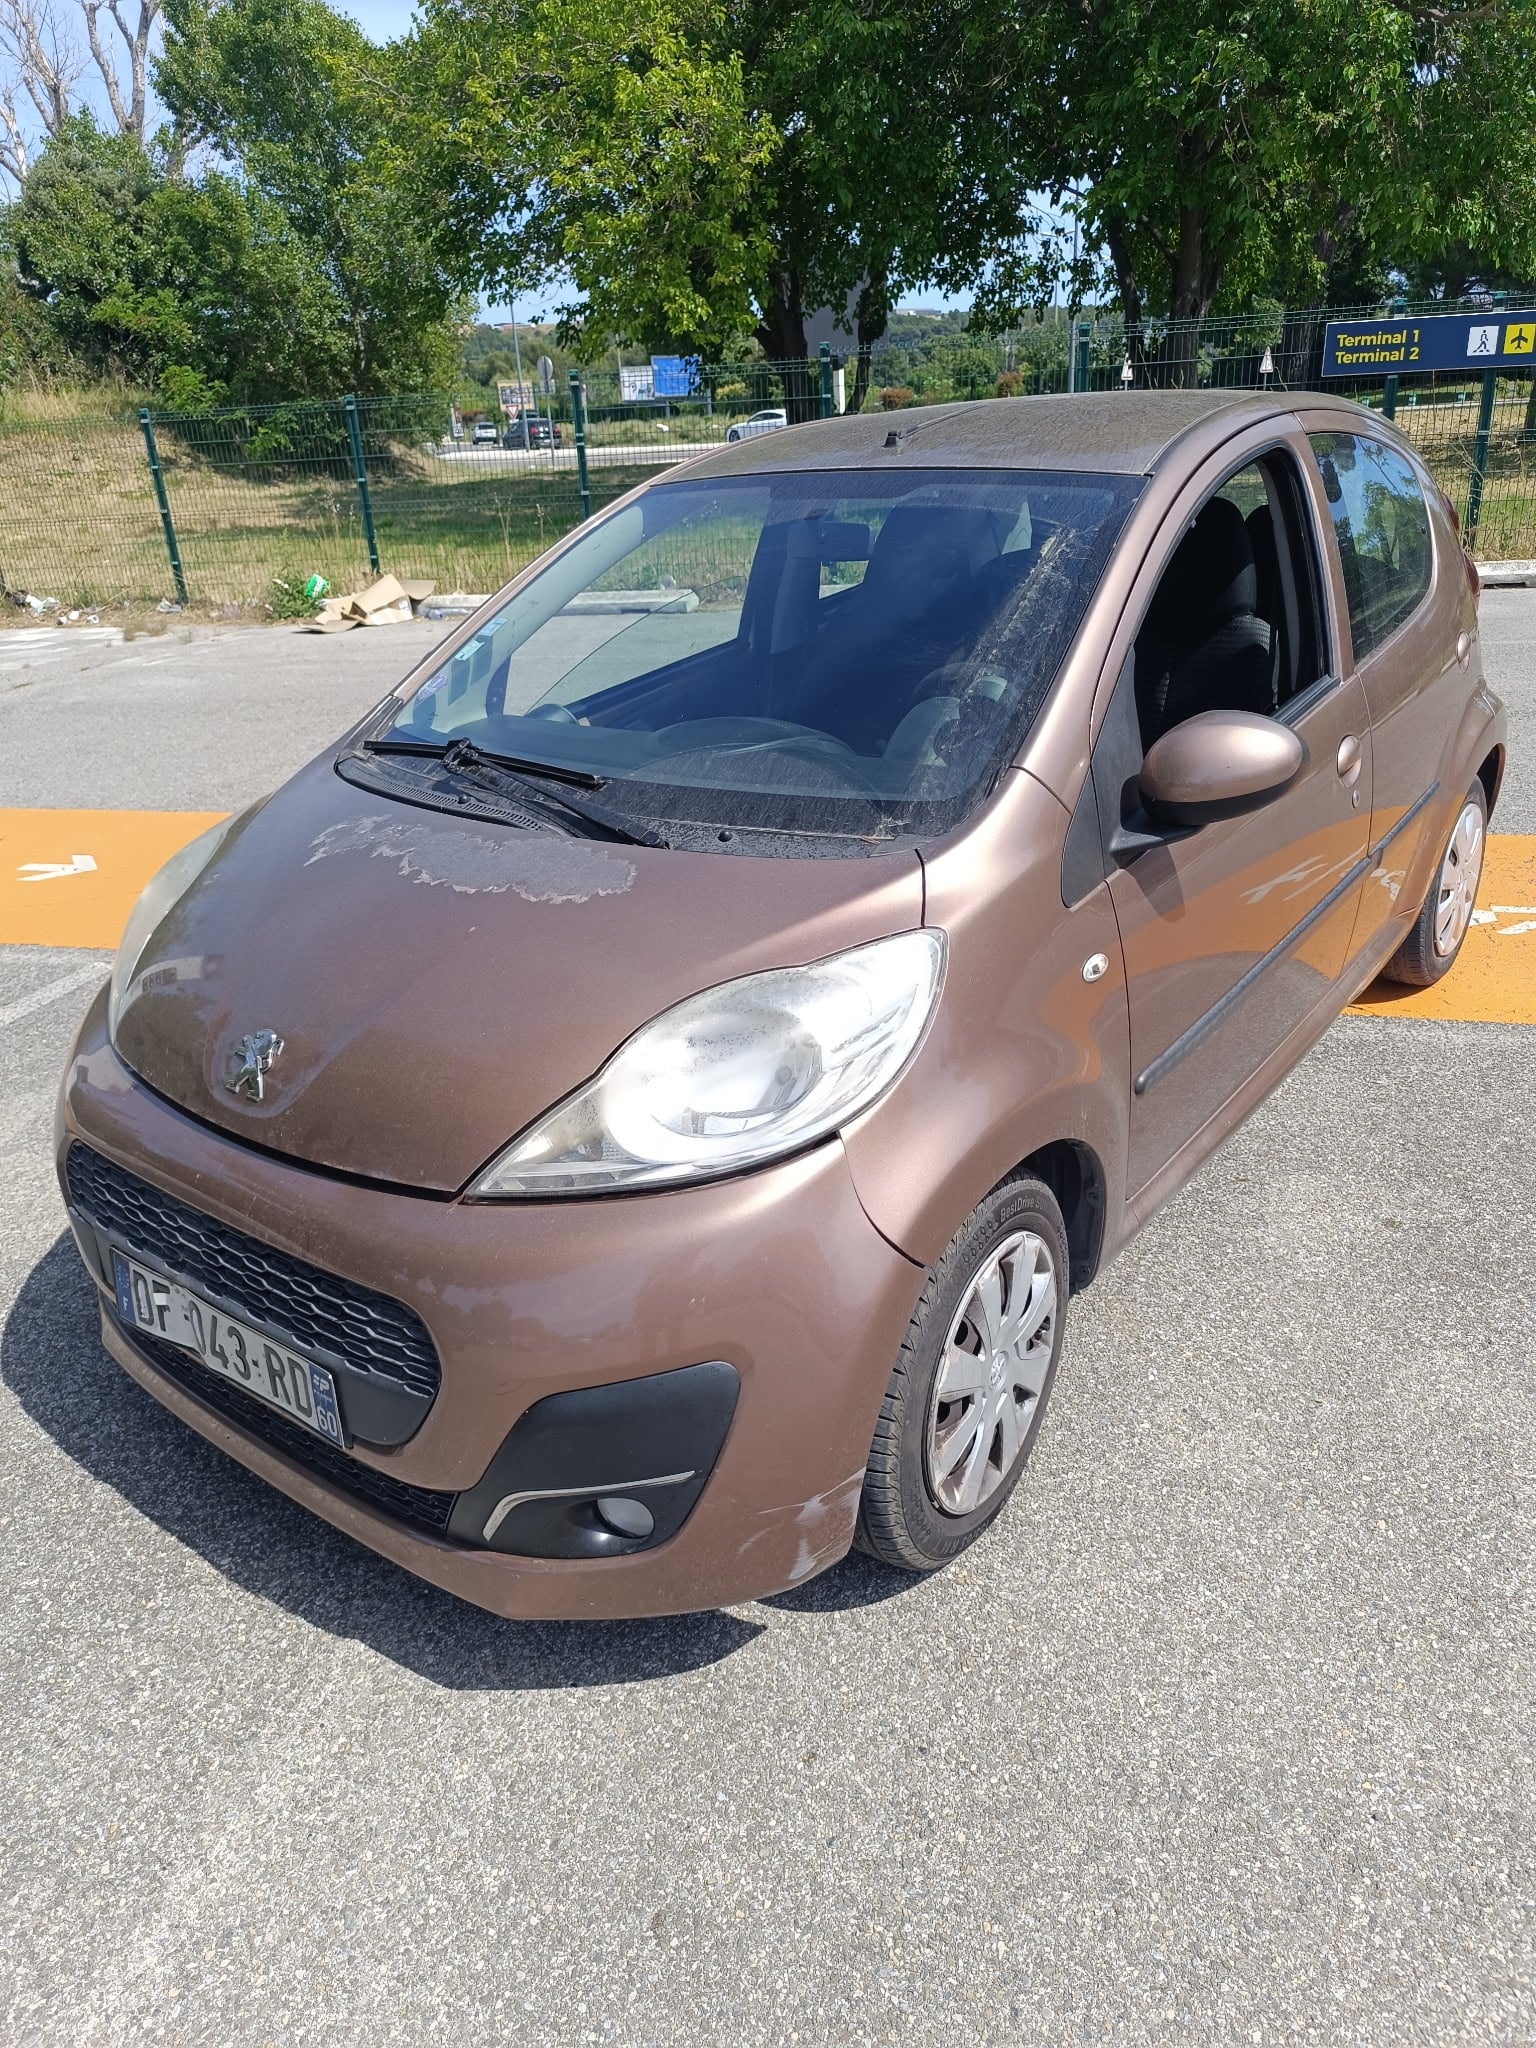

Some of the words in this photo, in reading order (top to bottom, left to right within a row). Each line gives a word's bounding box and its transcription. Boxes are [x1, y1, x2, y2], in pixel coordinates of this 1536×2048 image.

[1337, 330, 1407, 347] Terminal
[1413, 330, 1419, 343] 1
[1336, 347, 1404, 364] Terminal
[1409, 348, 1419, 360] 2
[317, 1405, 338, 1437] 60
